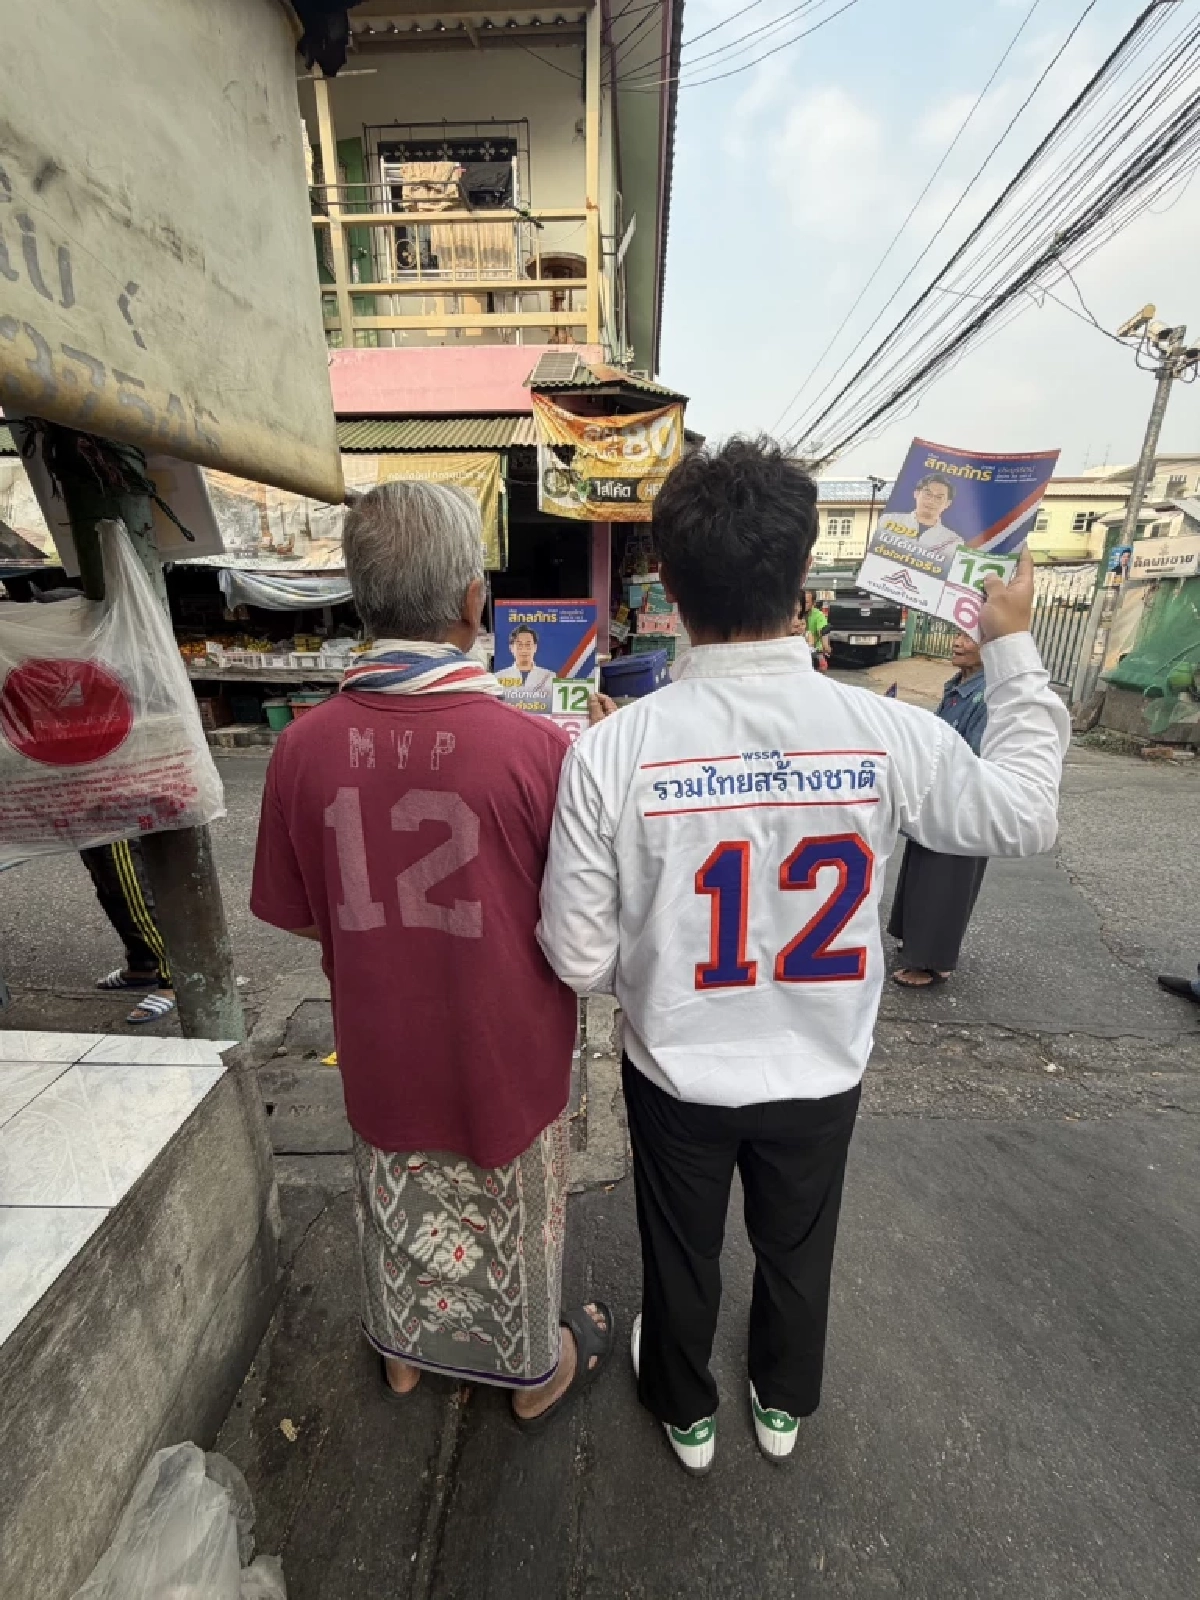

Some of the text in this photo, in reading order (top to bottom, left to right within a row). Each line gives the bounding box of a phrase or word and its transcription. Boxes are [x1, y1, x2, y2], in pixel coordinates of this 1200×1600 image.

[953, 596, 982, 631] 6
[557, 686, 590, 712] 12
[741, 750, 781, 762] พรรค
[652, 760, 877, 800] รวมไทยสร้างชาติ
[324, 787, 483, 938] 12
[694, 832, 875, 991] 12
